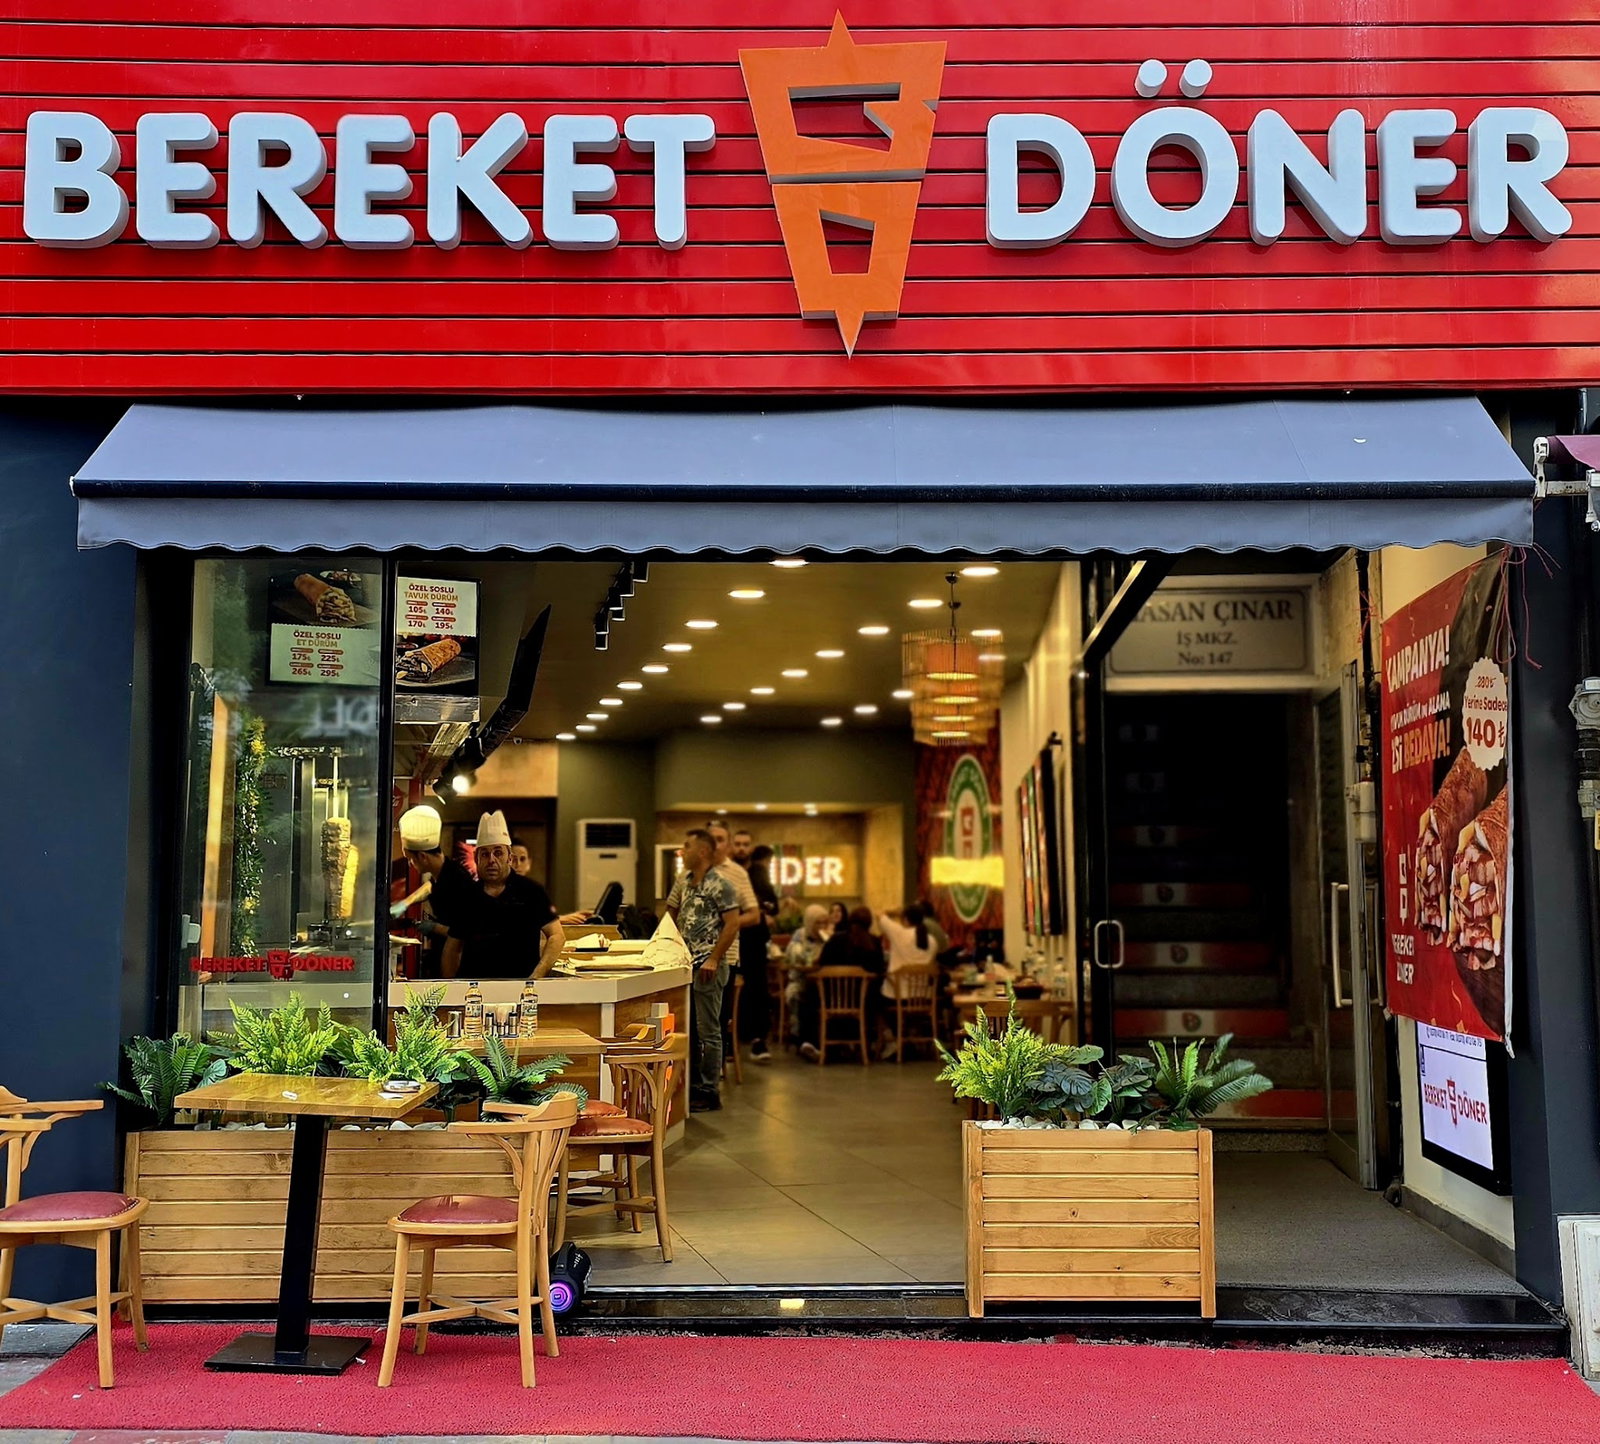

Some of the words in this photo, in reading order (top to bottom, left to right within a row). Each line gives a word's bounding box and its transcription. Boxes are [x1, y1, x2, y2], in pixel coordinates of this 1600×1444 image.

[23, 110, 716, 251] BEREKET
[986, 59, 1573, 247] DÖNER
[408, 583, 428, 592] ÖZEL
[430, 593, 459, 602] DÜRÜM
[1213, 600, 1294, 625] ÇINAR
[293, 629, 314, 639] ÖZEL
[315, 632, 341, 640] SOSLU
[308, 639, 338, 647] DÜRÜM
[1209, 652, 1233, 665] 147
[1457, 1090, 1488, 1125] DÖNER
